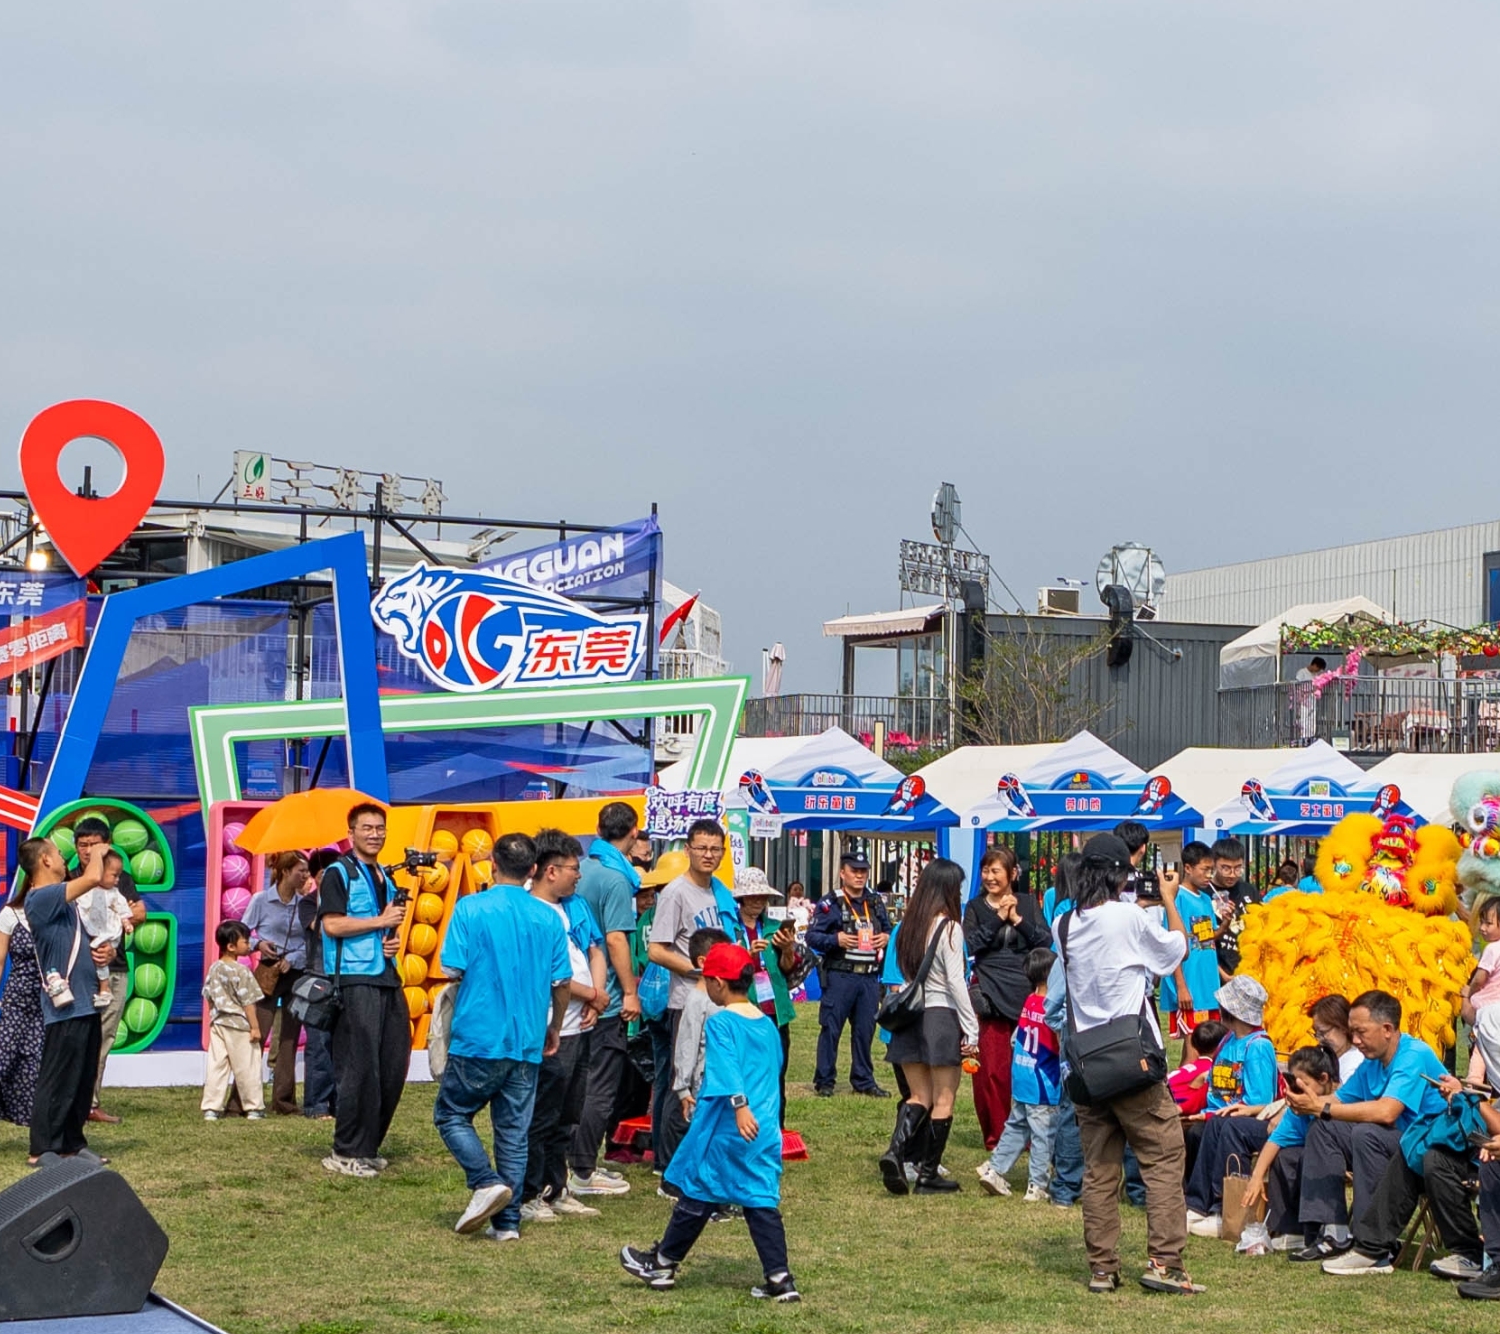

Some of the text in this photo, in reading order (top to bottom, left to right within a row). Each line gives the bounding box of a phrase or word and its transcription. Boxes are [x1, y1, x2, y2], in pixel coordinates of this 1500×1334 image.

[529, 630, 631, 673] 东莞
[804, 795, 856, 811] 玩乐童话
[648, 814, 716, 833] 退场有
[1023, 1025, 1039, 1055] 11
